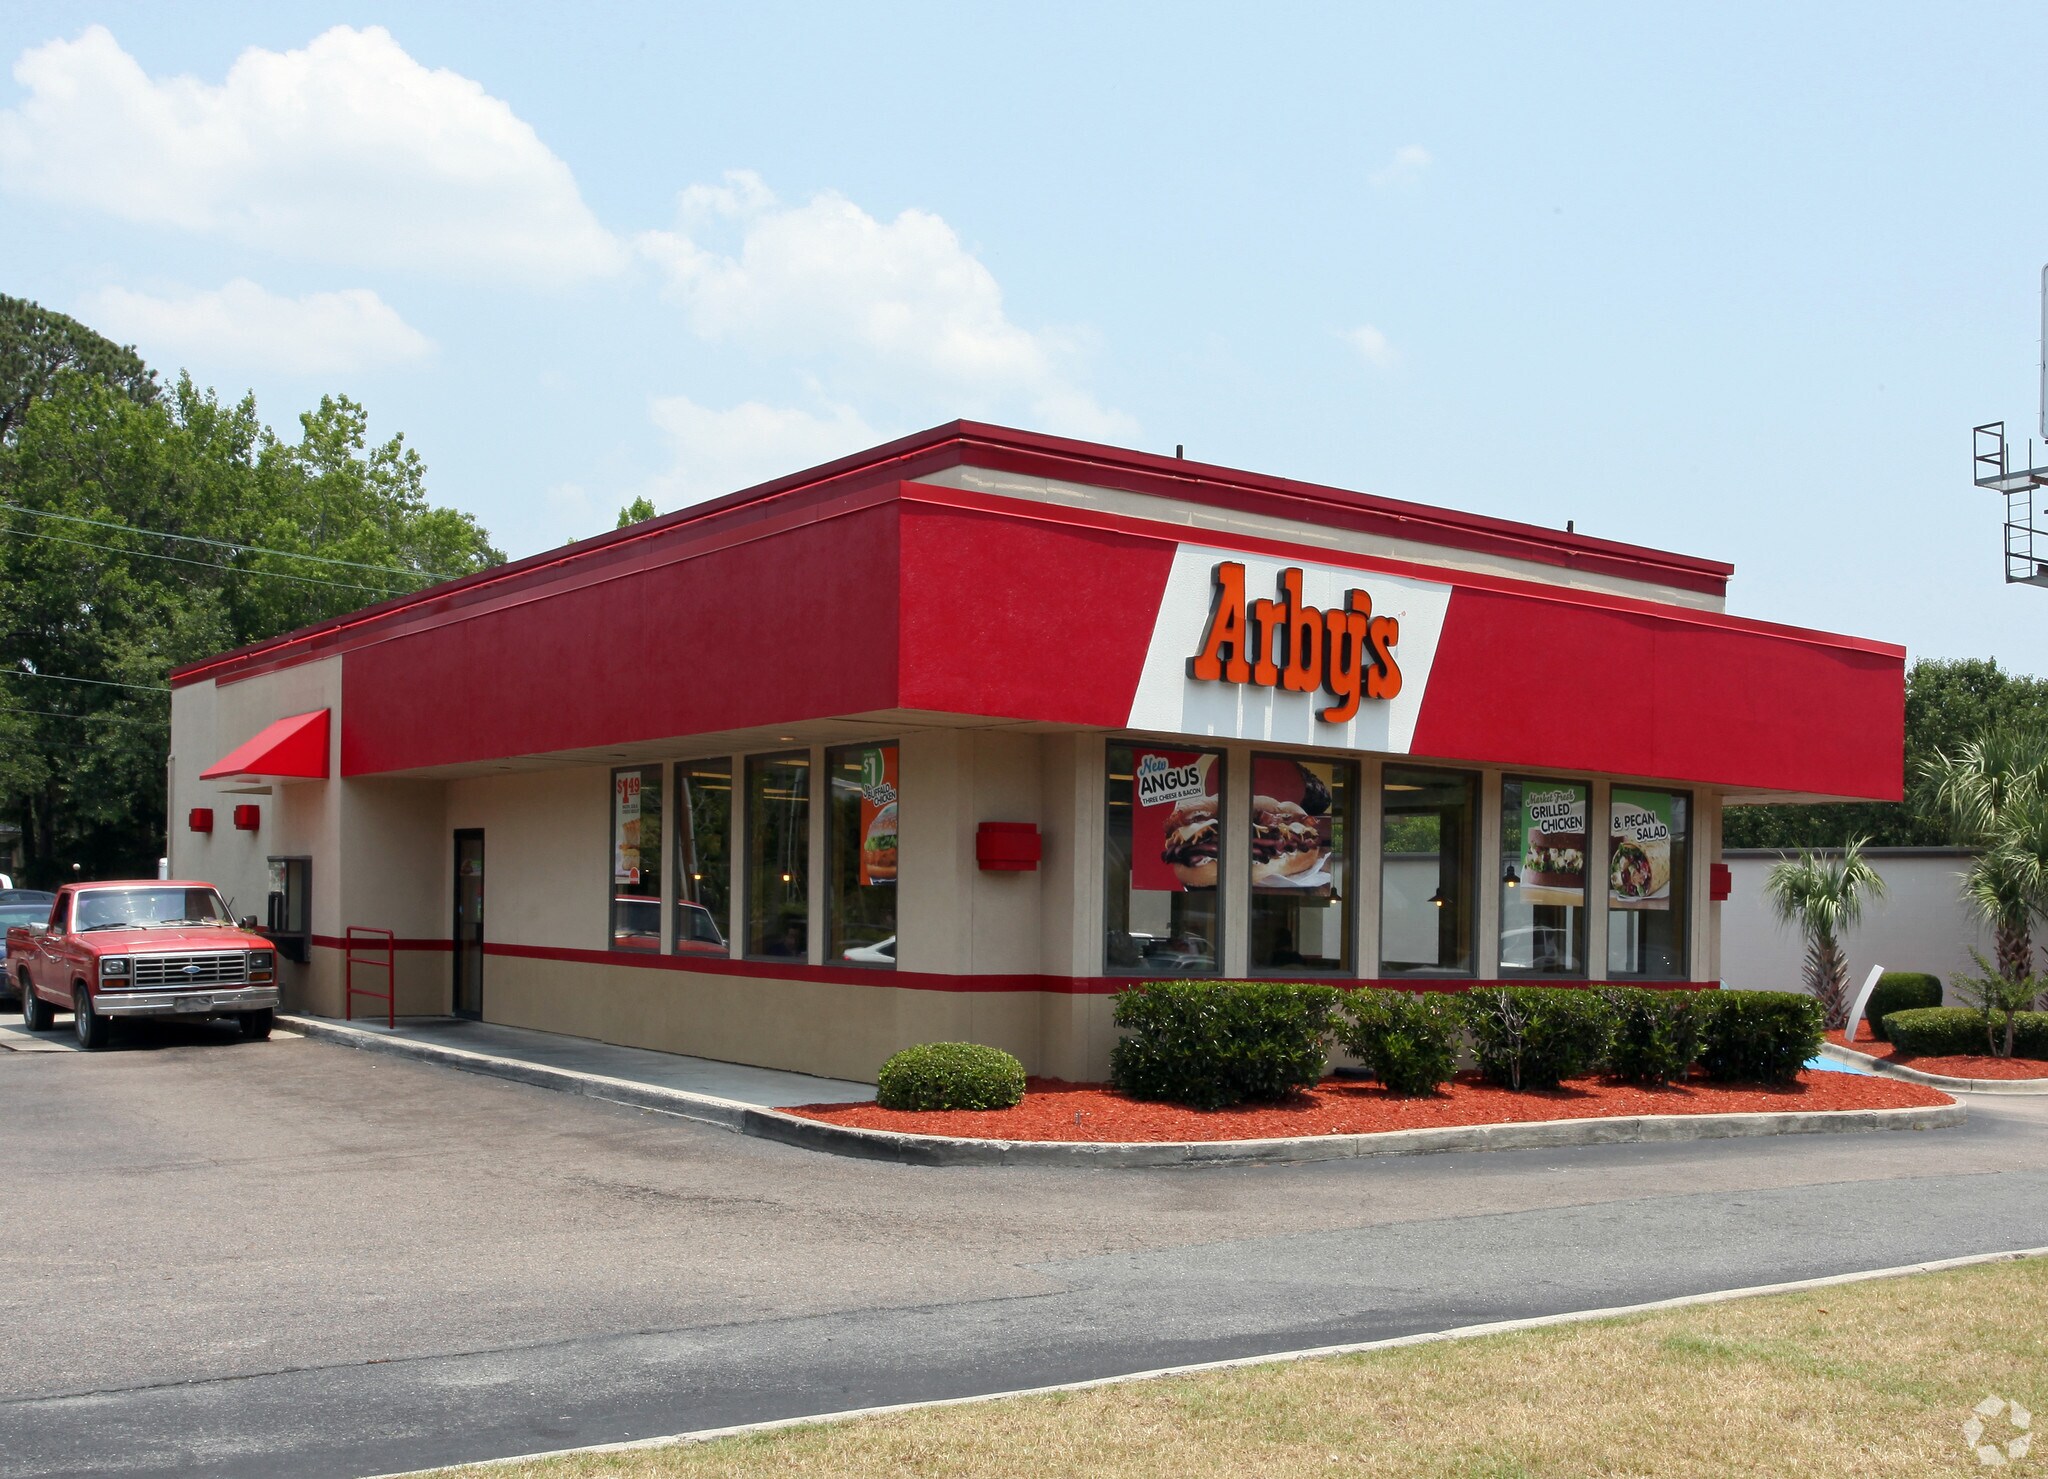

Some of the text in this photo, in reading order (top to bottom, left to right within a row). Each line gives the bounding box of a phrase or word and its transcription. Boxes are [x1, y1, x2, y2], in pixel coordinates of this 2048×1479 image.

[1185, 561, 1402, 723] Arby's
[864, 757, 876, 788] $1
[1140, 757, 1167, 776] New
[1141, 767, 1200, 796] ANGUS
[868, 783, 890, 800] BUFFALO
[874, 789, 896, 806] CHICKEN
[1142, 796, 1158, 804] THREE
[1159, 792, 1177, 801] CHEESE
[1183, 787, 1201, 796] BACON
[1526, 790, 1575, 806] Market Fresh
[1531, 803, 1570, 819] GRILLED
[1541, 816, 1583, 832] CHICKEN
[1613, 812, 1655, 829] & PECAN
[1636, 825, 1667, 840] SALAD
